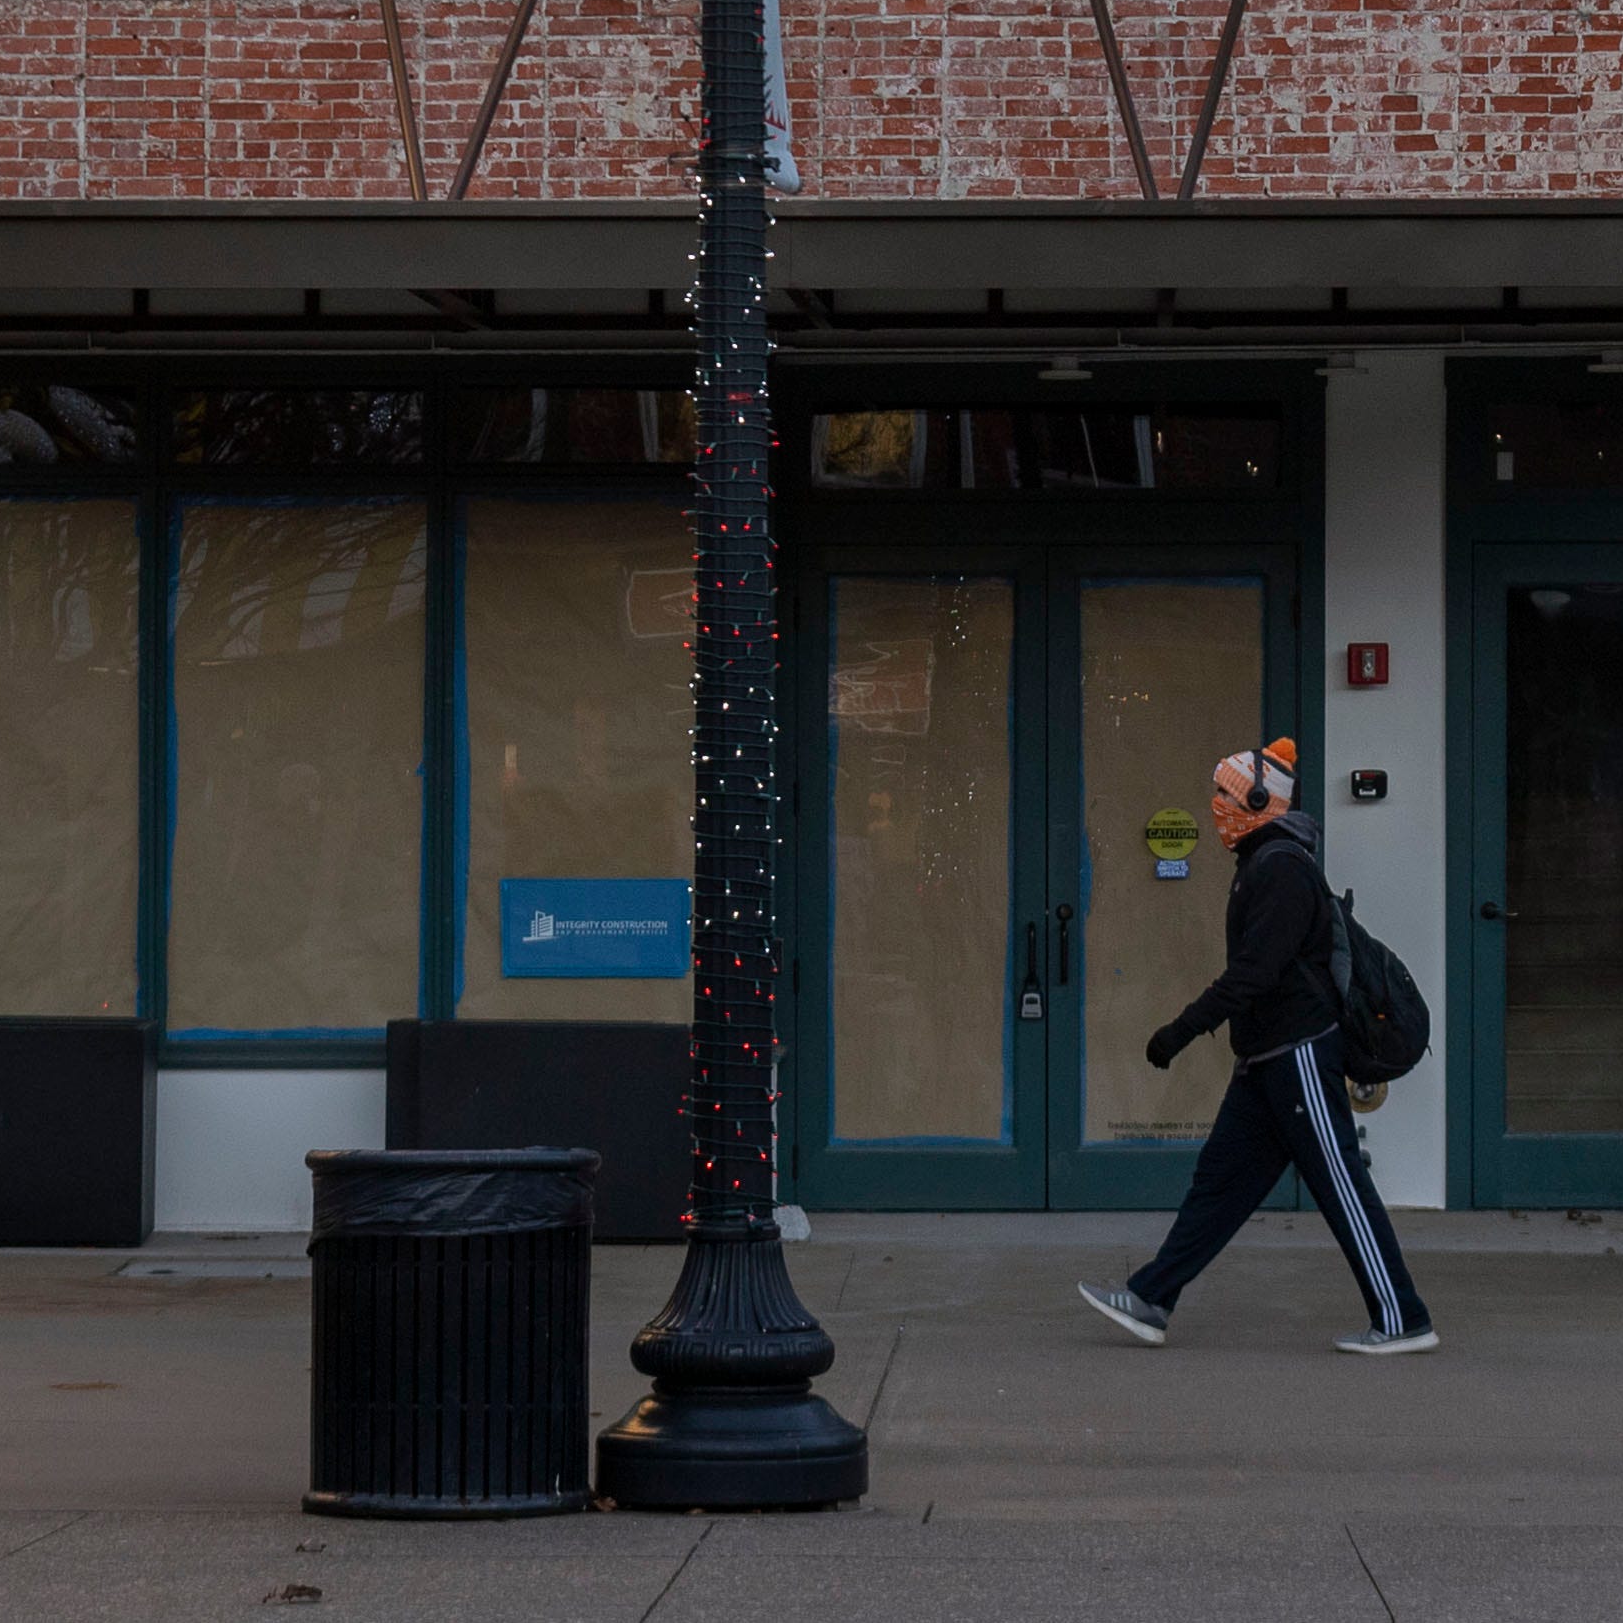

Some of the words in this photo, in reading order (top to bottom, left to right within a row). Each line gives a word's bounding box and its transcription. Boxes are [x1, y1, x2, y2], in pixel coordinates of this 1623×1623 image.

[1148, 829, 1197, 838] CAUTION
[555, 920, 599, 929] INTEGRITY
[601, 920, 668, 929] CONSTRUCTION
